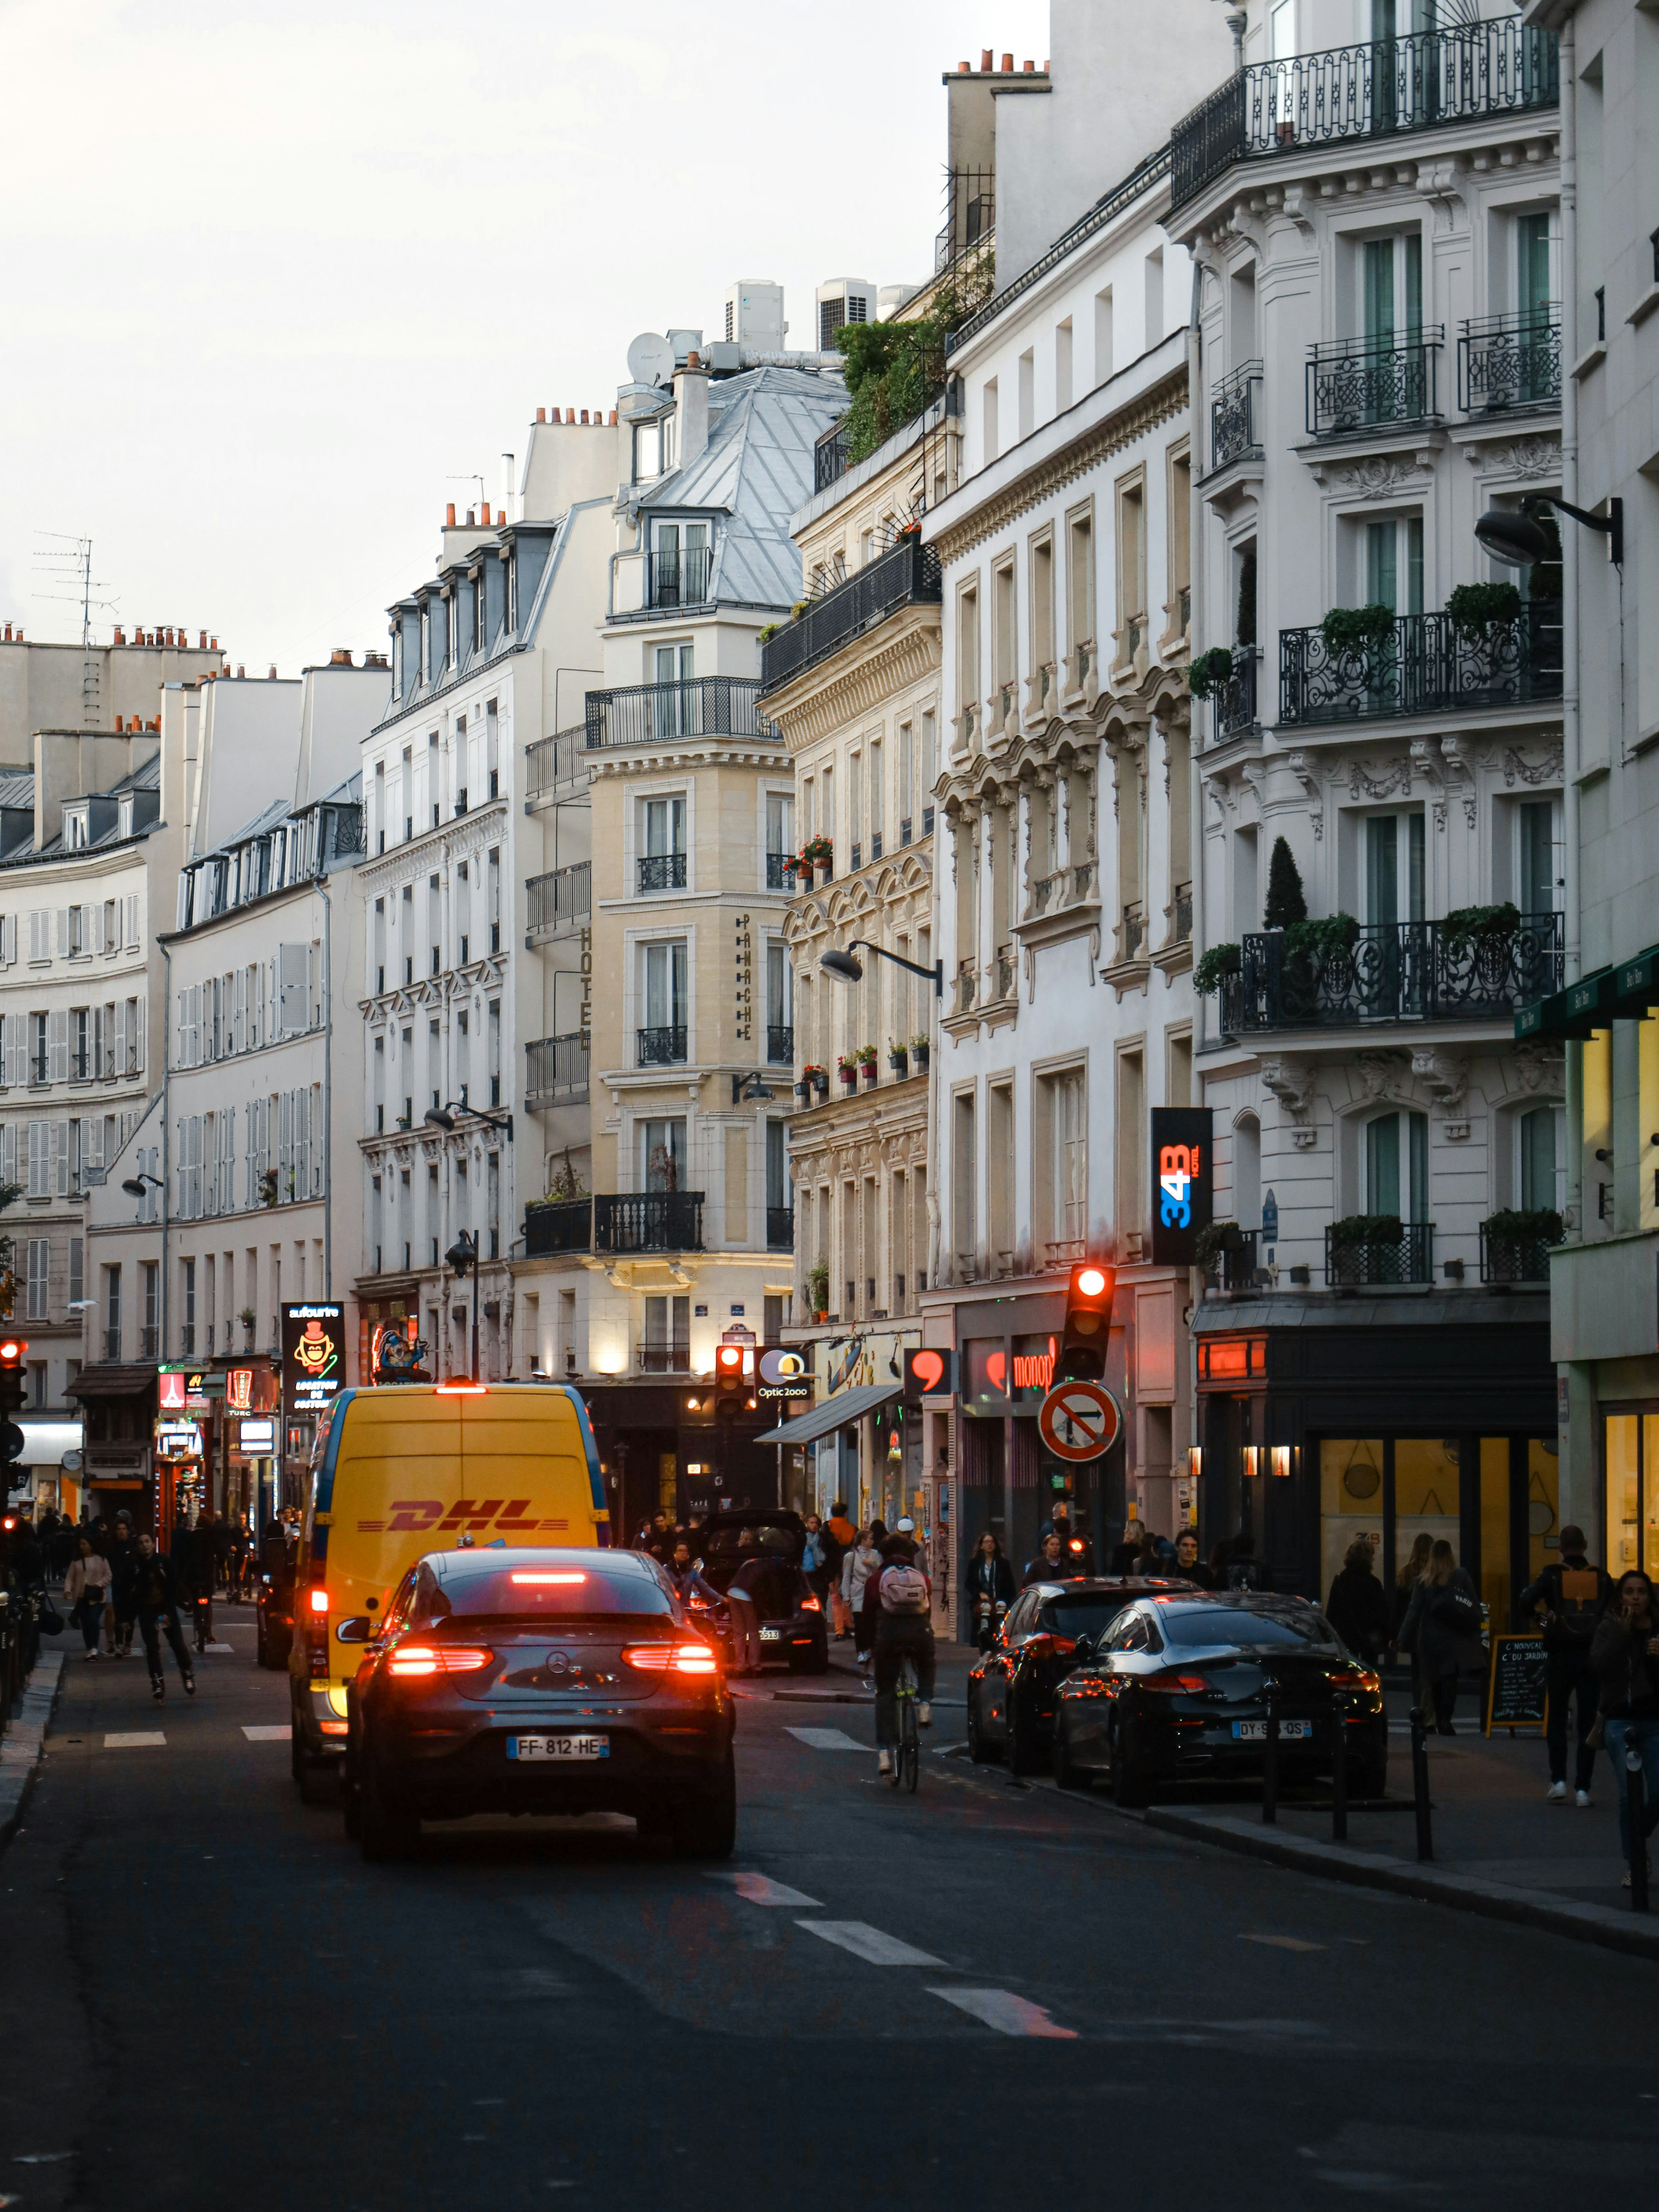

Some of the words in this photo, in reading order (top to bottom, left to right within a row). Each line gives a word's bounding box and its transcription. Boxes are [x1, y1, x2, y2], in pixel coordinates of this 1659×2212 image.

[743, 914, 751, 1041] PANACHE
[580, 928, 591, 1051] HOTEL
[1191, 1145, 1199, 1178] HOTEL
[1160, 1144, 1190, 1229] 34B
[289, 1306, 339, 1318] aufourire
[295, 1381, 338, 1391] LOCATION
[310, 1390, 323, 1399] DE
[758, 1387, 784, 1399] Optic
[784, 1388, 807, 1396] 2000
[294, 1400, 331, 1409] COSTUM
[387, 1500, 540, 1531] DHL
[1512, 1653, 1522, 1661] DU
[1241, 1722, 1302, 1735] DY-9-QS
[518, 1739, 599, 1754] FF-812-HE
